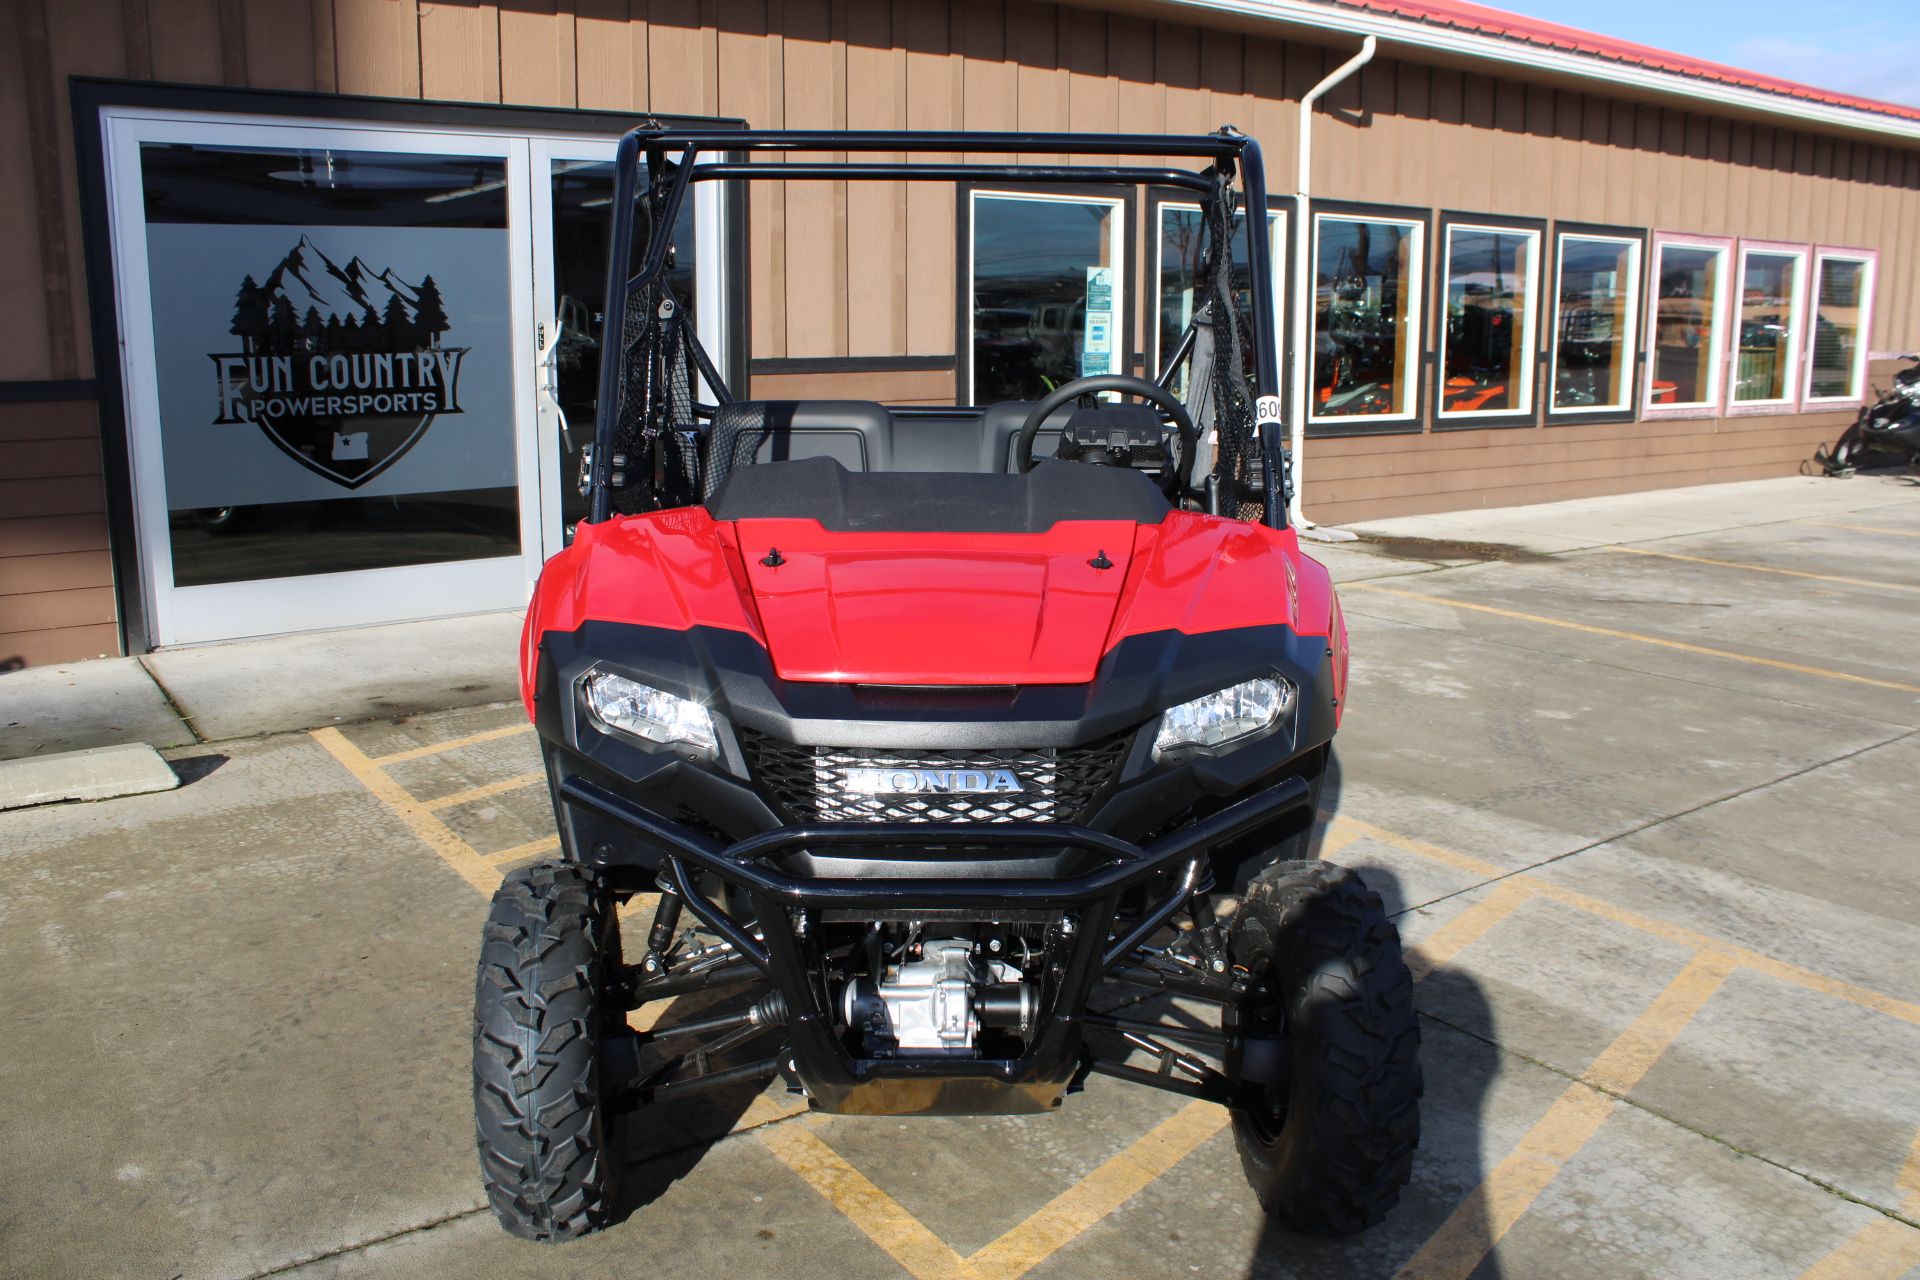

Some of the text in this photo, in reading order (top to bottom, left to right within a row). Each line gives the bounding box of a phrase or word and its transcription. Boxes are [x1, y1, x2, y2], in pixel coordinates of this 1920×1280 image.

[219, 351, 461, 420] FUN COUNTRY
[250, 392, 438, 418] POWERSPORTS
[1256, 401, 1281, 418] 60
[845, 767, 1025, 793] HONDA
